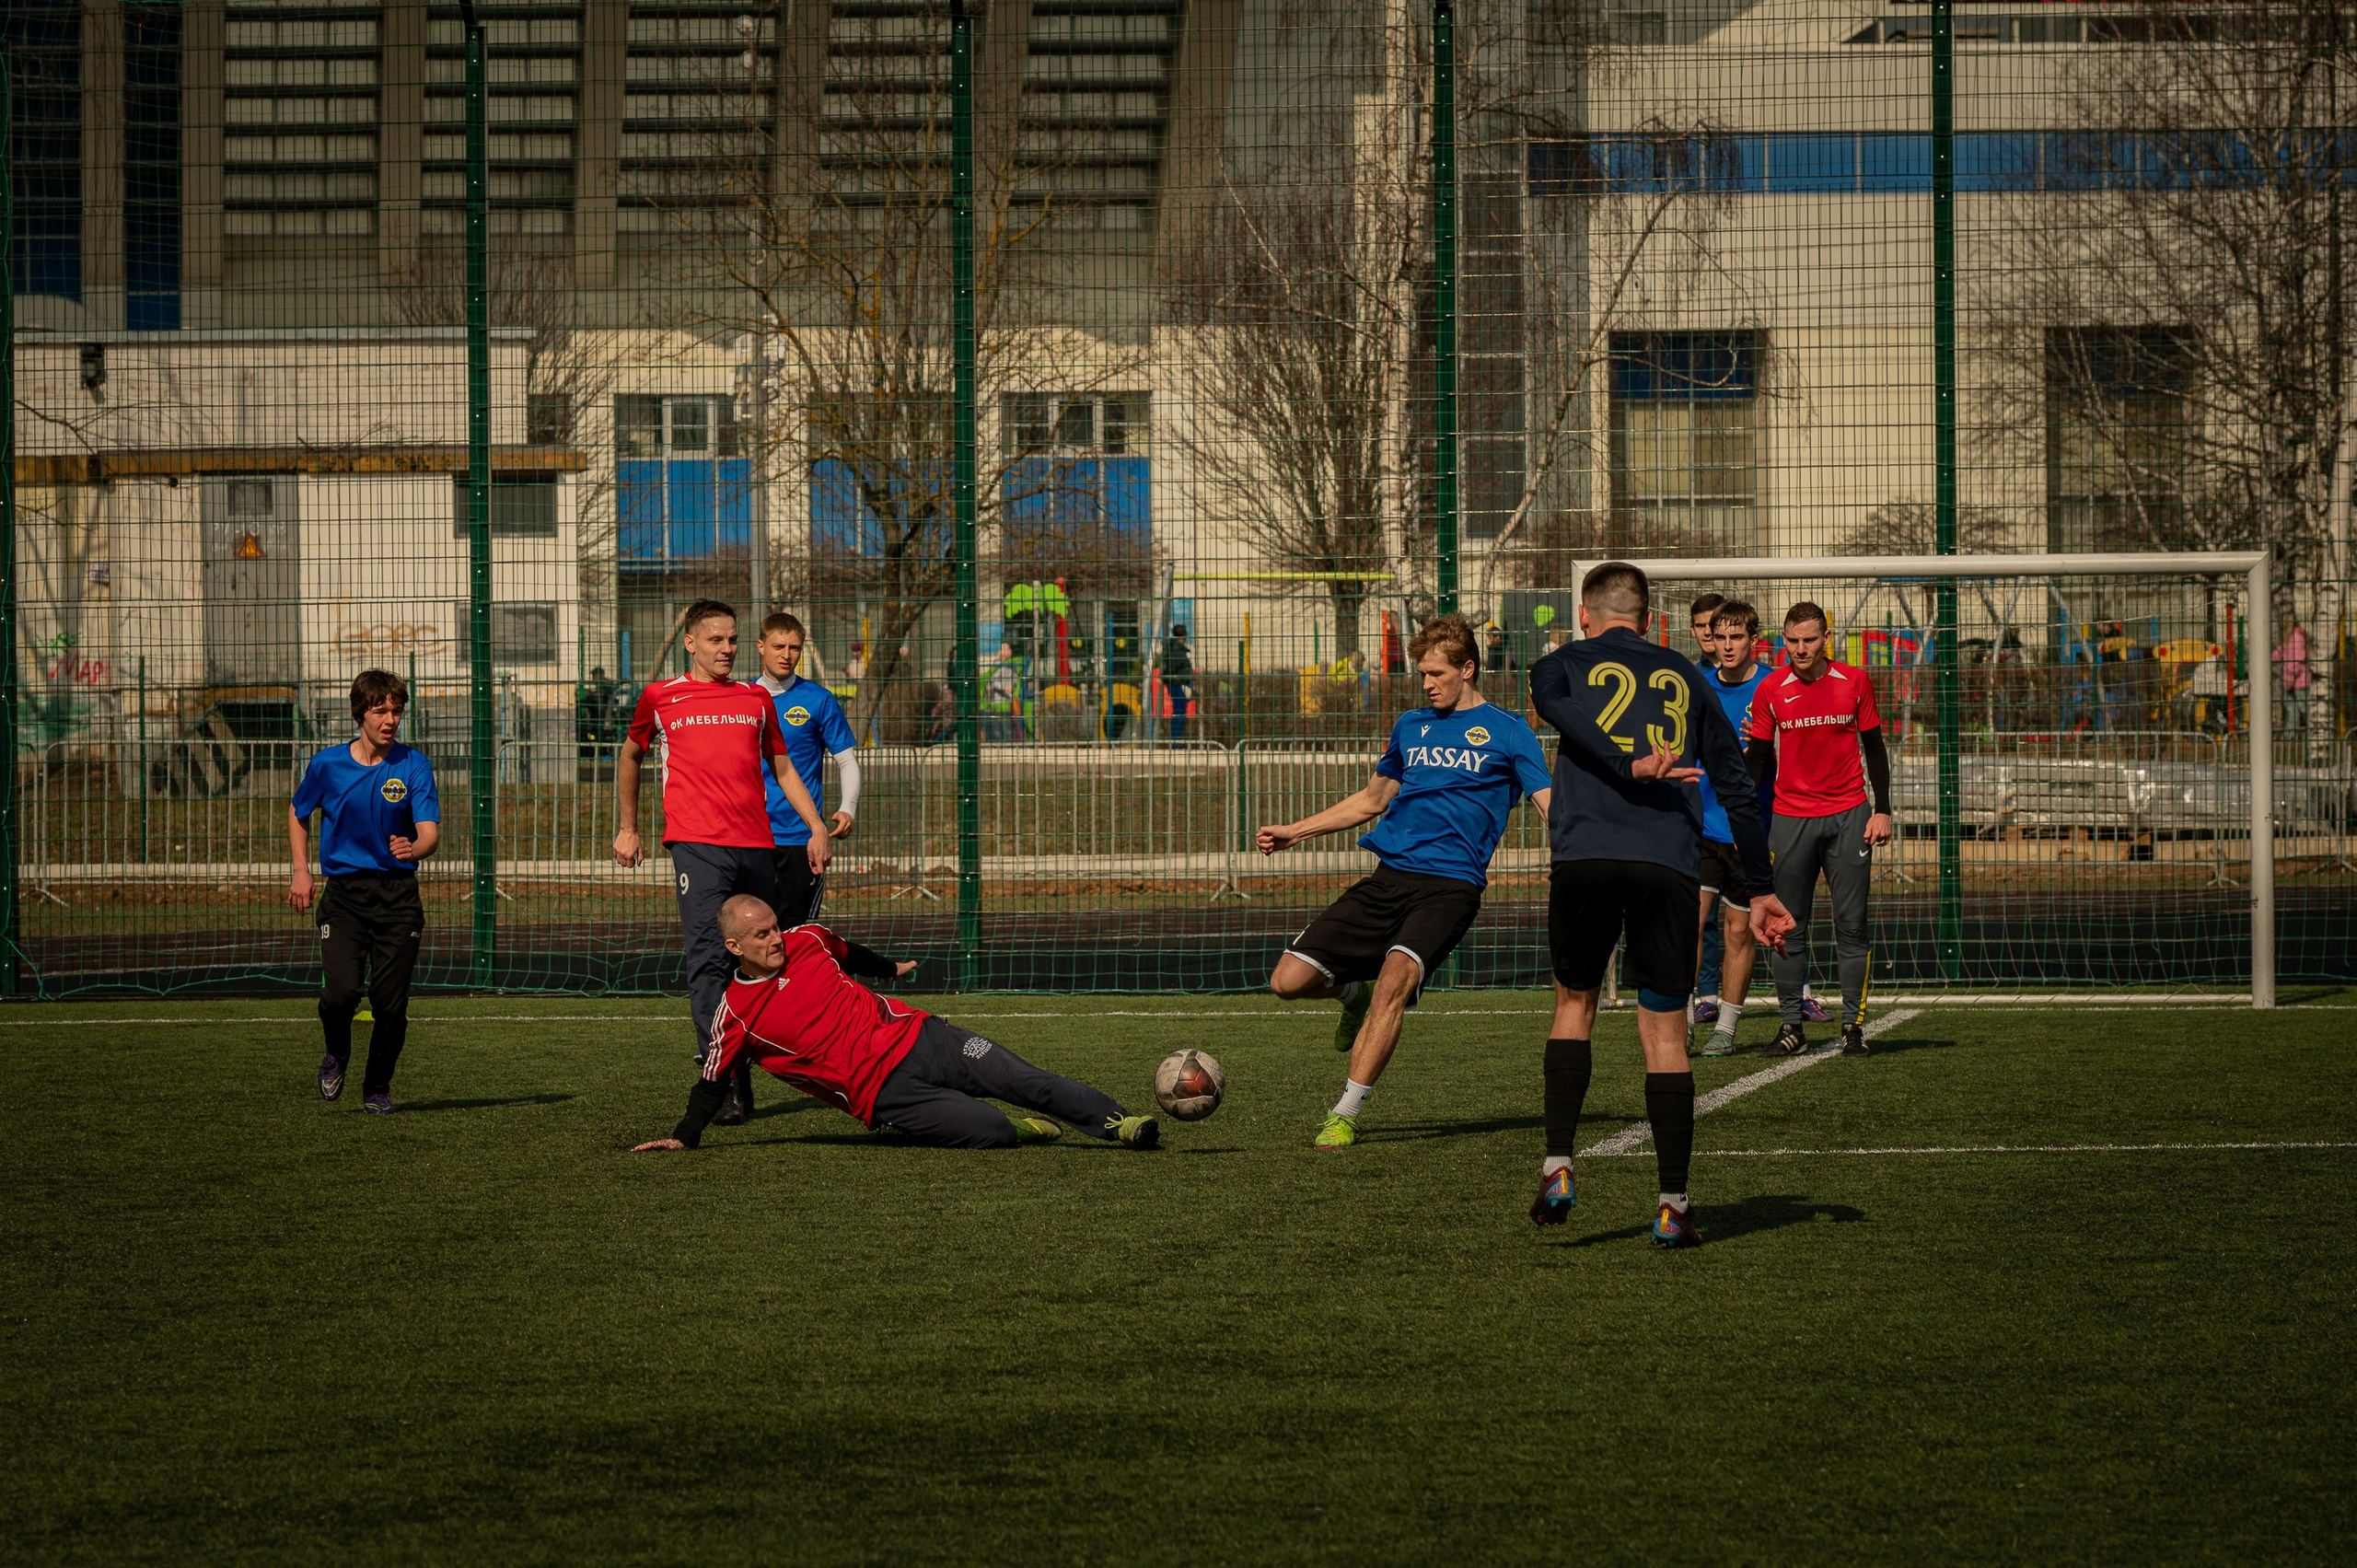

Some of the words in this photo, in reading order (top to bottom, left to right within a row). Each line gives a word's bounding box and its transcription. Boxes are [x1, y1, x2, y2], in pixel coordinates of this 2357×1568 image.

[1588, 662, 1689, 756] 23
[670, 717, 683, 731] ФК
[1780, 720, 1794, 729] ФК
[1794, 714, 1854, 728] МЕБЕЛЬЩИ
[1407, 747, 1490, 773] TASSAY
[679, 873, 690, 896] 9
[320, 923, 331, 939] 19
